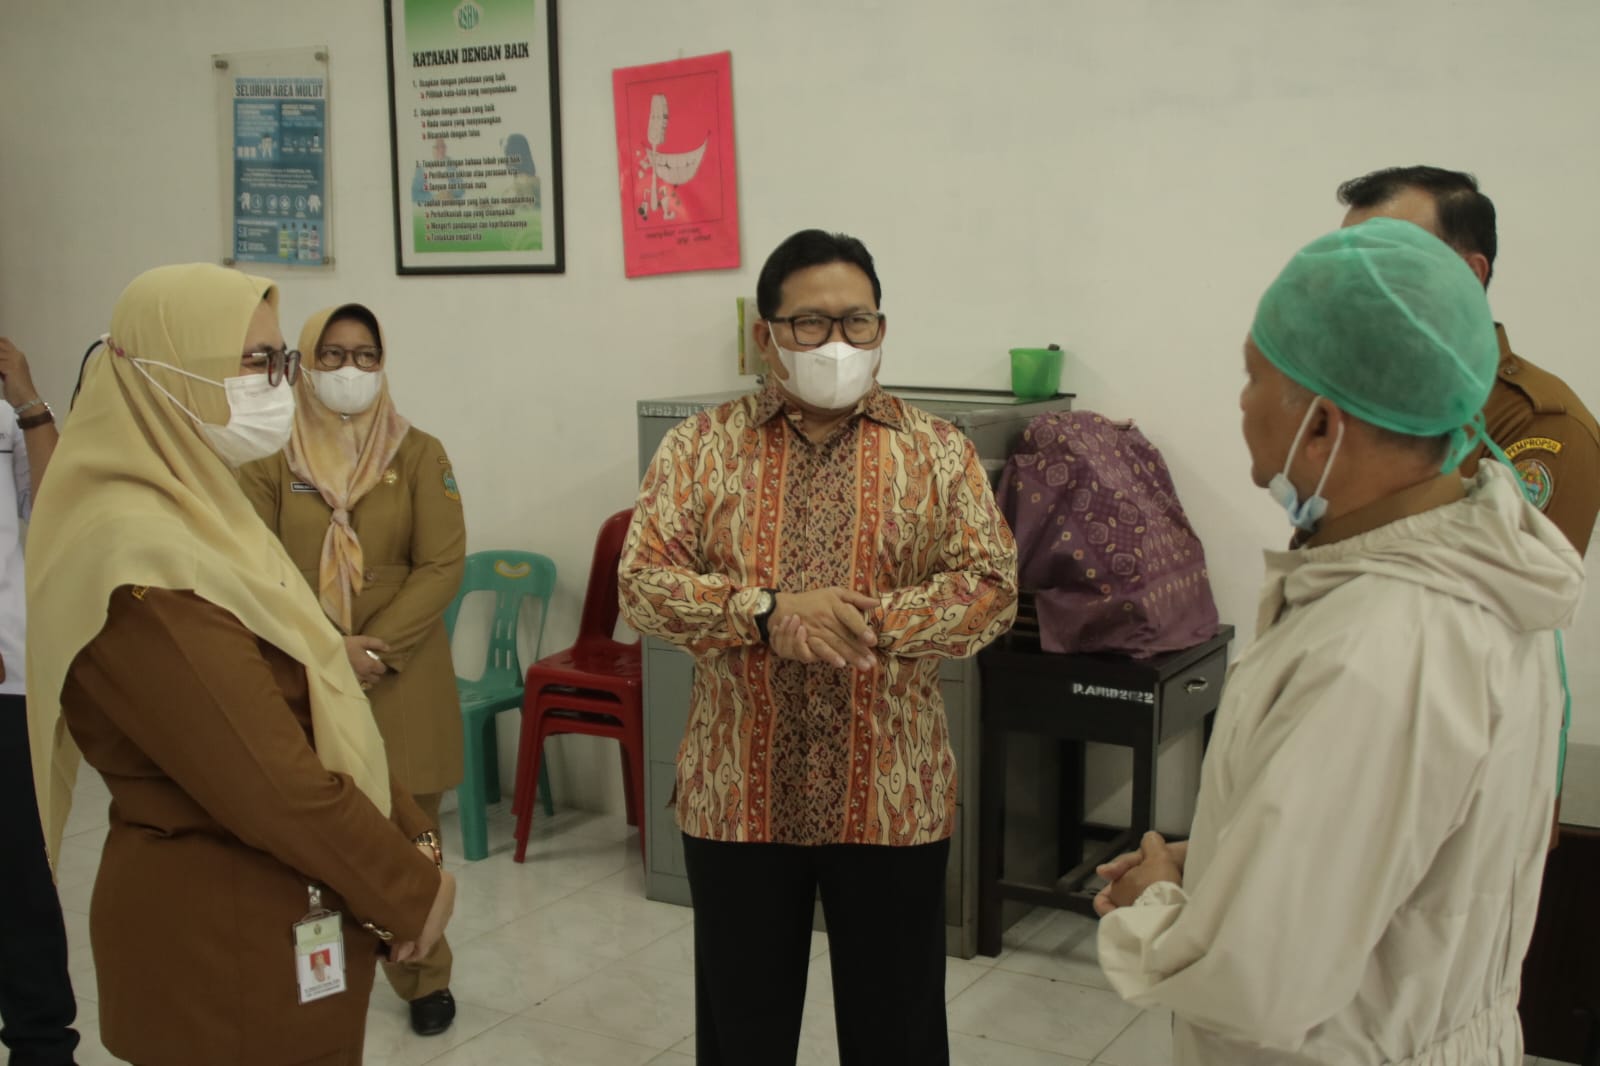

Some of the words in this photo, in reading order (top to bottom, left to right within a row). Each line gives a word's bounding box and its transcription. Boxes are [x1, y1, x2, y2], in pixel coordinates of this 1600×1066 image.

[412, 48, 459, 68] KATAKAN
[461, 44, 502, 63] DENGAN
[504, 42, 529, 60] BAIK
[440, 78, 457, 87] dengan
[483, 75, 495, 84] yang
[495, 73, 506, 81] baik
[235, 85, 271, 97] SELURUH
[272, 84, 294, 97] AREA
[296, 84, 323, 97] MULUT
[468, 87, 479, 96] yang
[441, 106, 458, 116] dengan
[472, 105, 483, 114] yang
[453, 118, 465, 128] yang
[450, 130, 467, 139] dengan
[447, 159, 464, 168] dengan
[473, 209, 485, 218] yang
